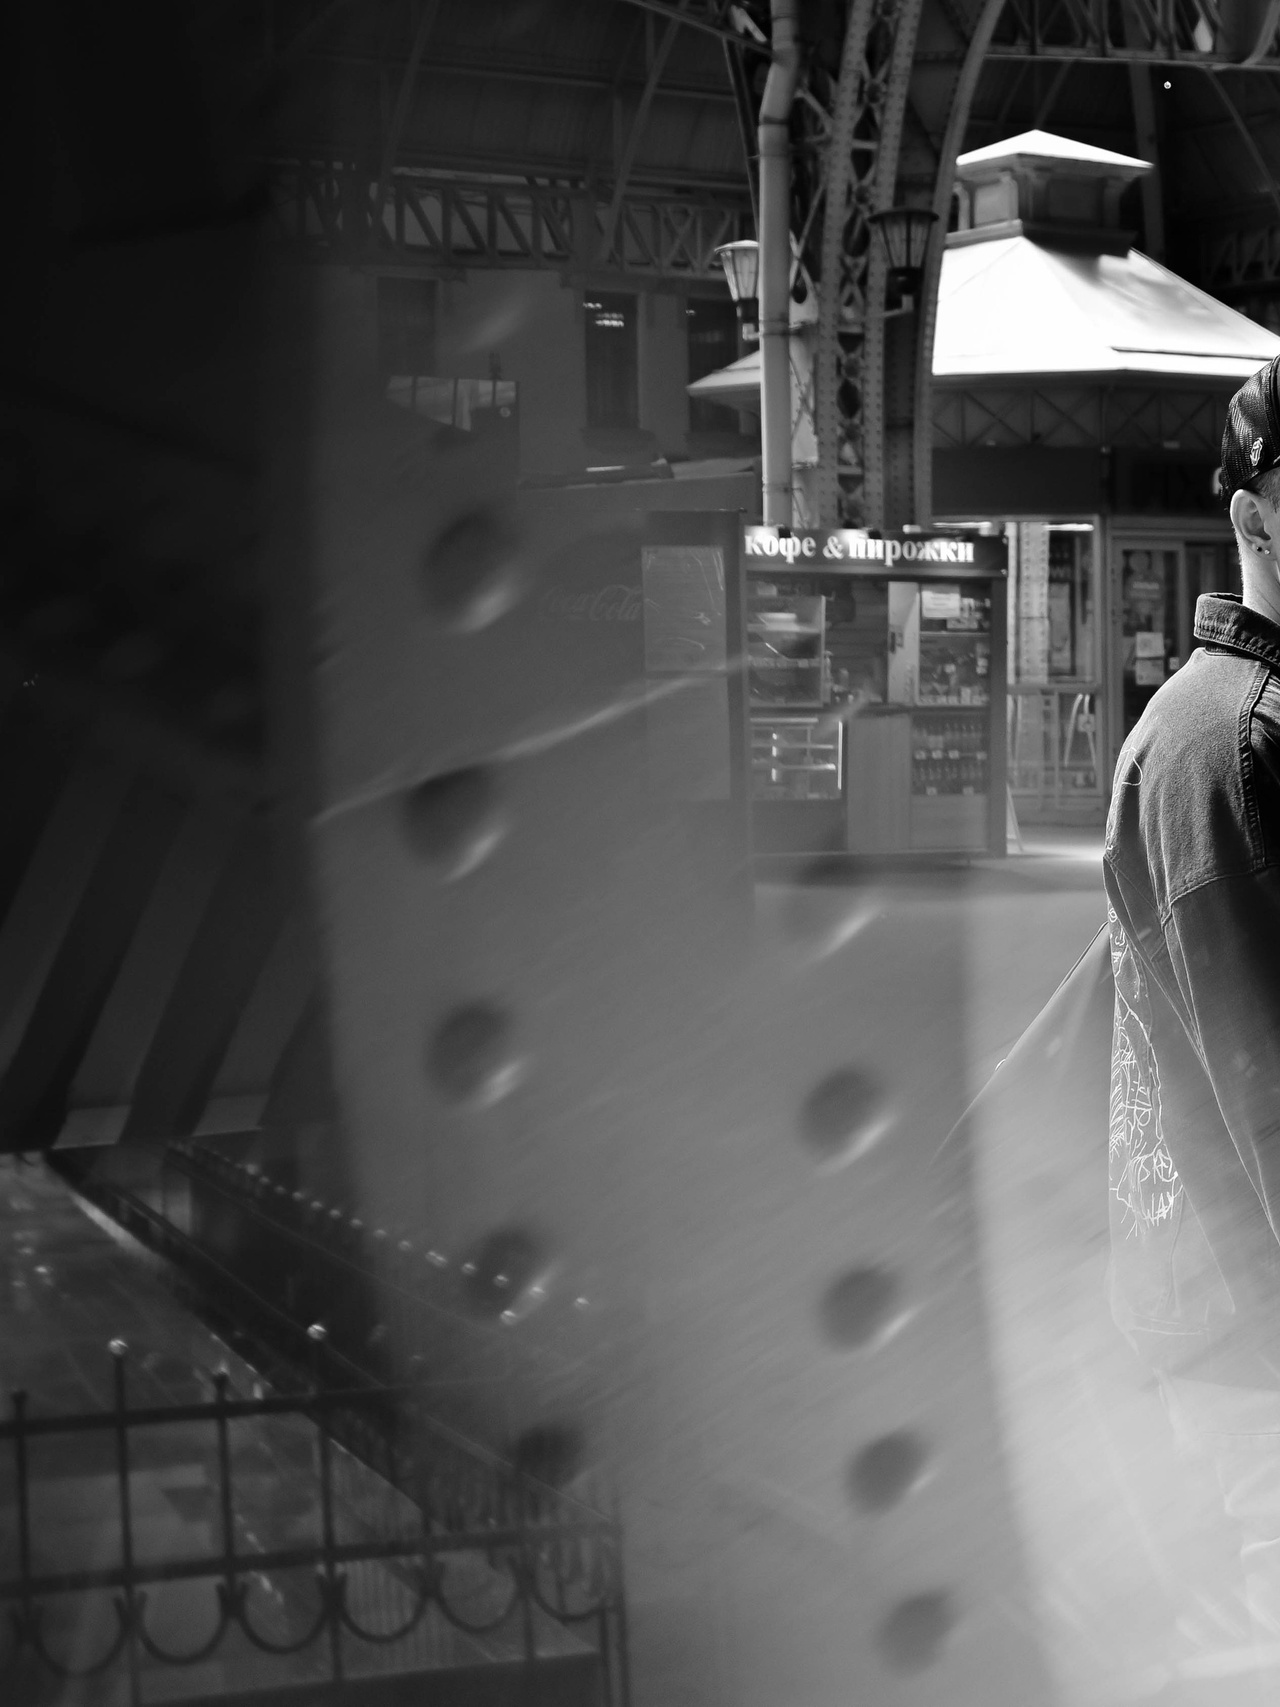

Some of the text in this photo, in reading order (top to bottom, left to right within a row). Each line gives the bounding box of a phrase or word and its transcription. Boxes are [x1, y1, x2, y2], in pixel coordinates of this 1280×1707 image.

[745, 535, 974, 567] кофе & пирожки
